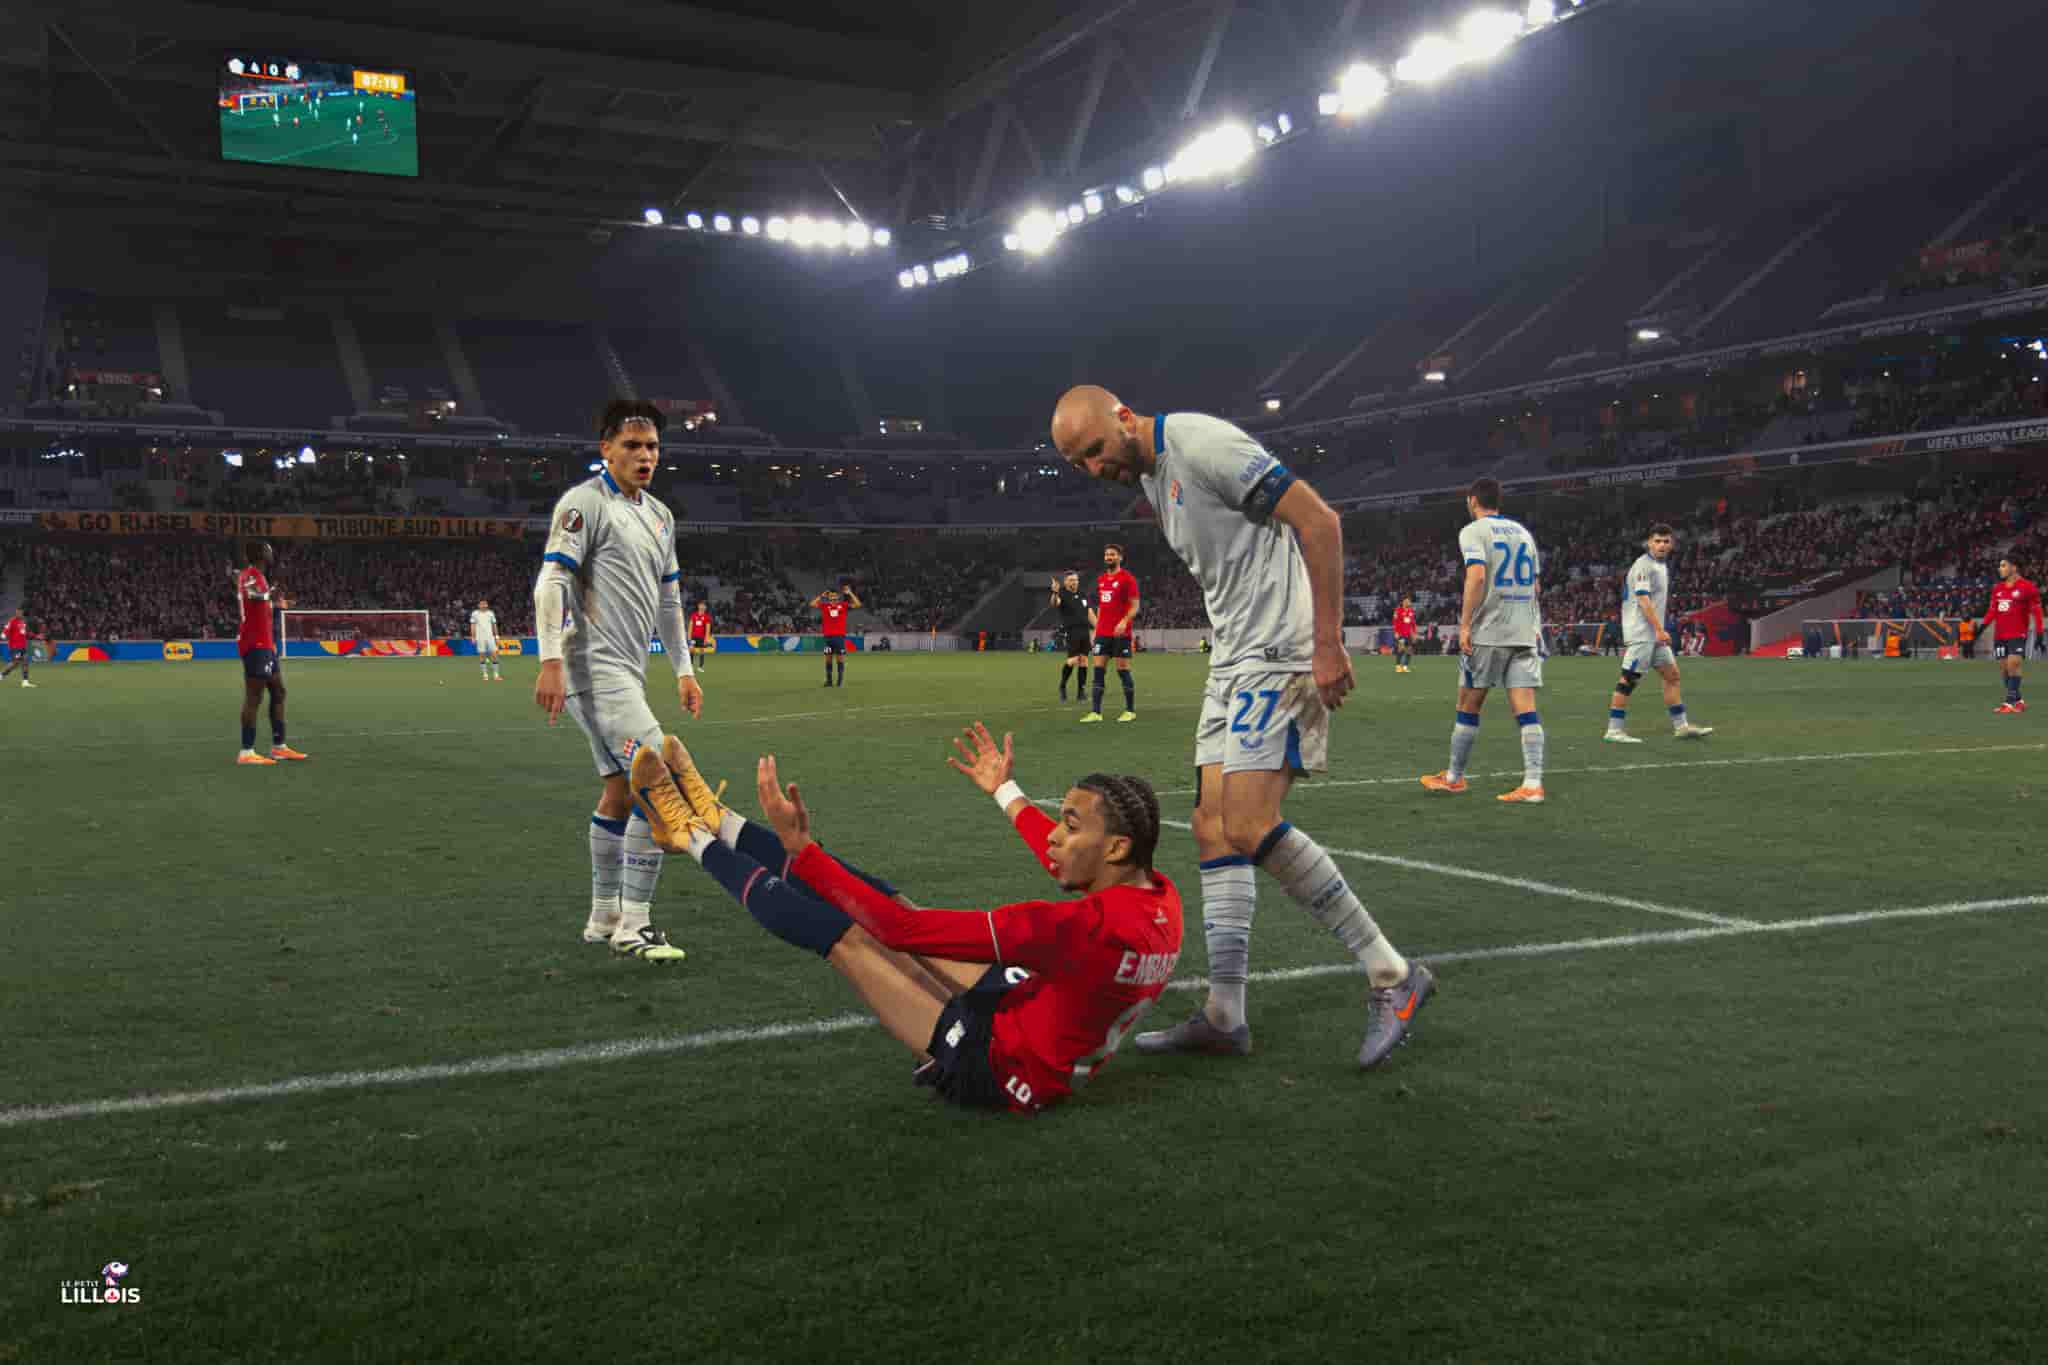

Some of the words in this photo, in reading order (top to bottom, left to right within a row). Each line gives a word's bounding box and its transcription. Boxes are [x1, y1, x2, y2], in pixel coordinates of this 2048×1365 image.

[79, 513, 110, 531] GO
[205, 514, 273, 536] SPIRIT
[314, 518, 396, 537] TRIBUNE
[400, 518, 441, 538] SUD
[446, 519, 498, 538] LILLE
[1493, 542, 1533, 586] 26
[1231, 689, 1282, 733] 27
